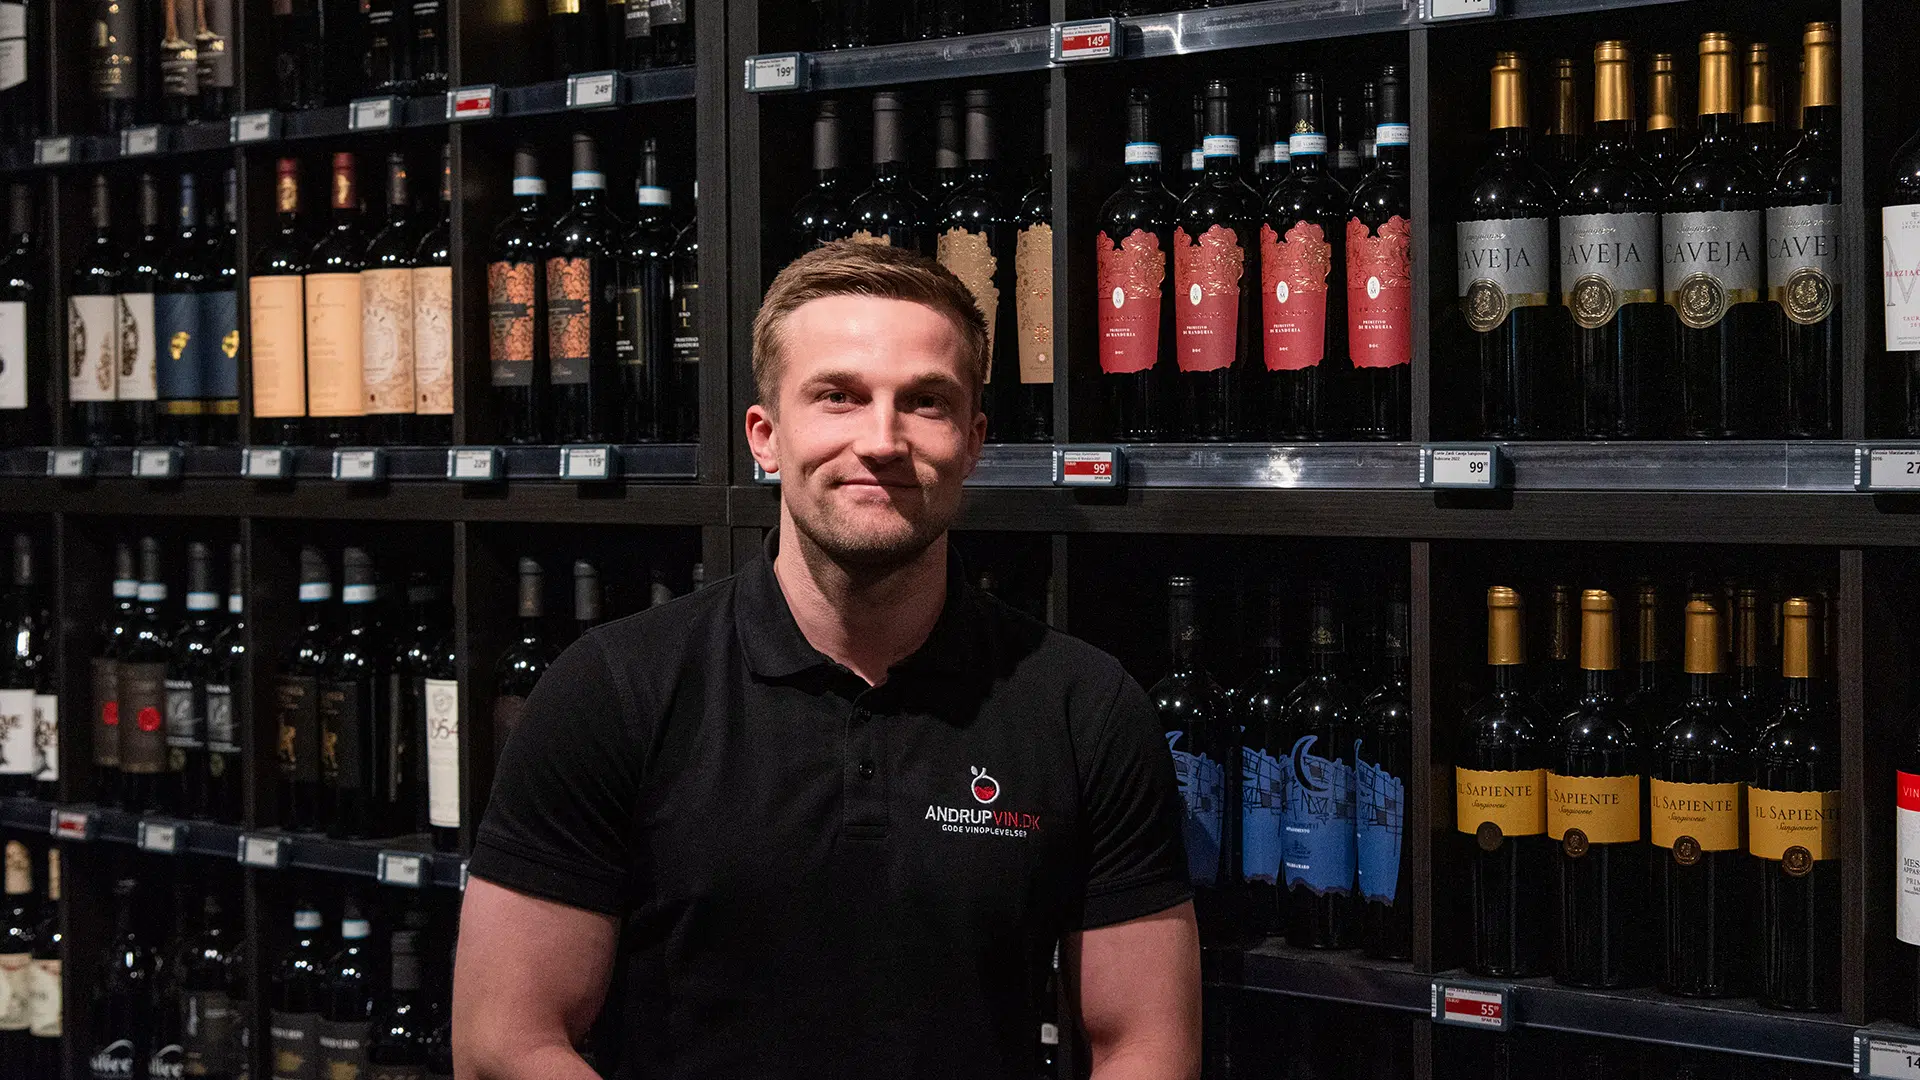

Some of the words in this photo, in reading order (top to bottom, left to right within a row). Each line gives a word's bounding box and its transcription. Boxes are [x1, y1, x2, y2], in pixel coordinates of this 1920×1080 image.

[1086, 36, 1104, 47] 149
[776, 66, 791, 77] 199
[1458, 248, 1532, 273] AVEJA
[1664, 242, 1750, 268] CAVEJA
[1093, 463, 1105, 474] 99
[1470, 461, 1483, 473] 99
[1466, 783, 1532, 796] SAPIENTE
[1554, 789, 1620, 805] SAPIENTE
[1663, 796, 1733, 812] SAPIENTE
[942, 824, 963, 833] GODE
[1481, 1004, 1494, 1016] 55
